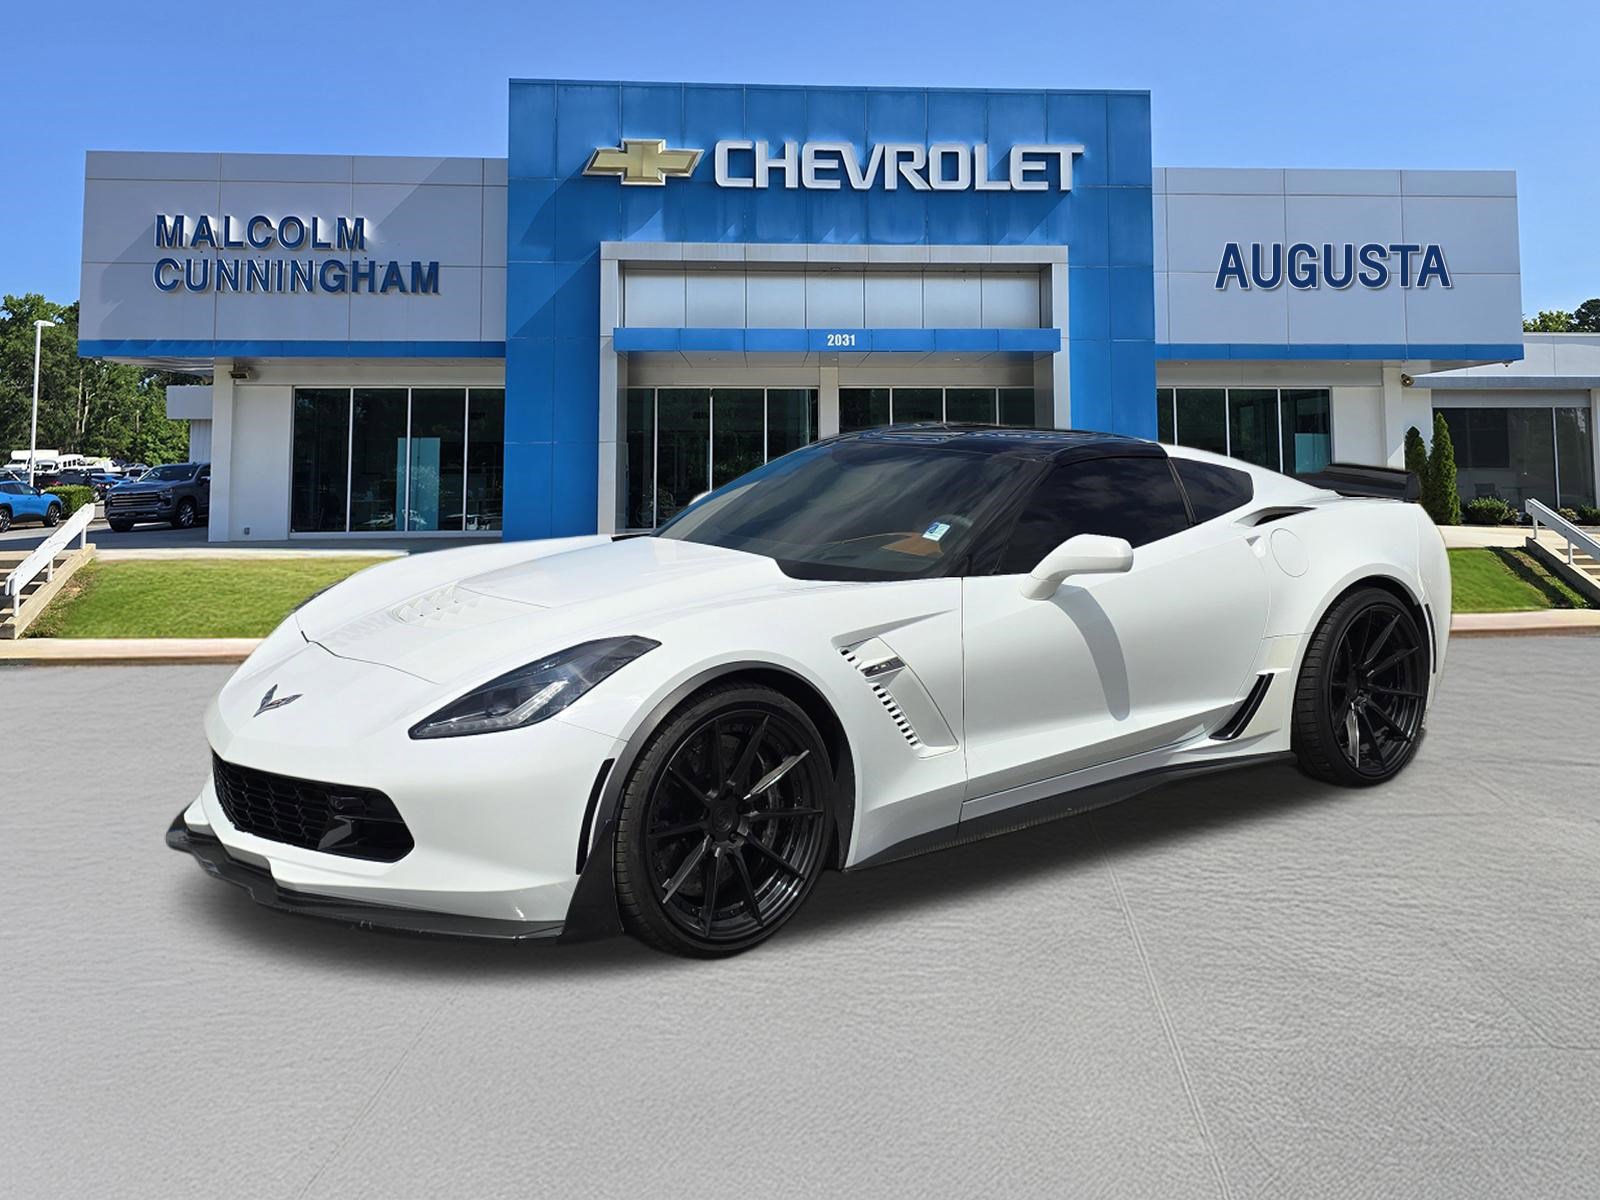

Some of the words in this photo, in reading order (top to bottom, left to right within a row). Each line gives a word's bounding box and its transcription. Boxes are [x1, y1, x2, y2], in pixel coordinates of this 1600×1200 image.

[714, 140, 1085, 191] CHEVROLET
[154, 214, 365, 250] MALCOLM
[153, 257, 440, 293] CUNNINGHAM
[1214, 241, 1453, 289] AUGUSTA
[826, 333, 856, 347] 2031
